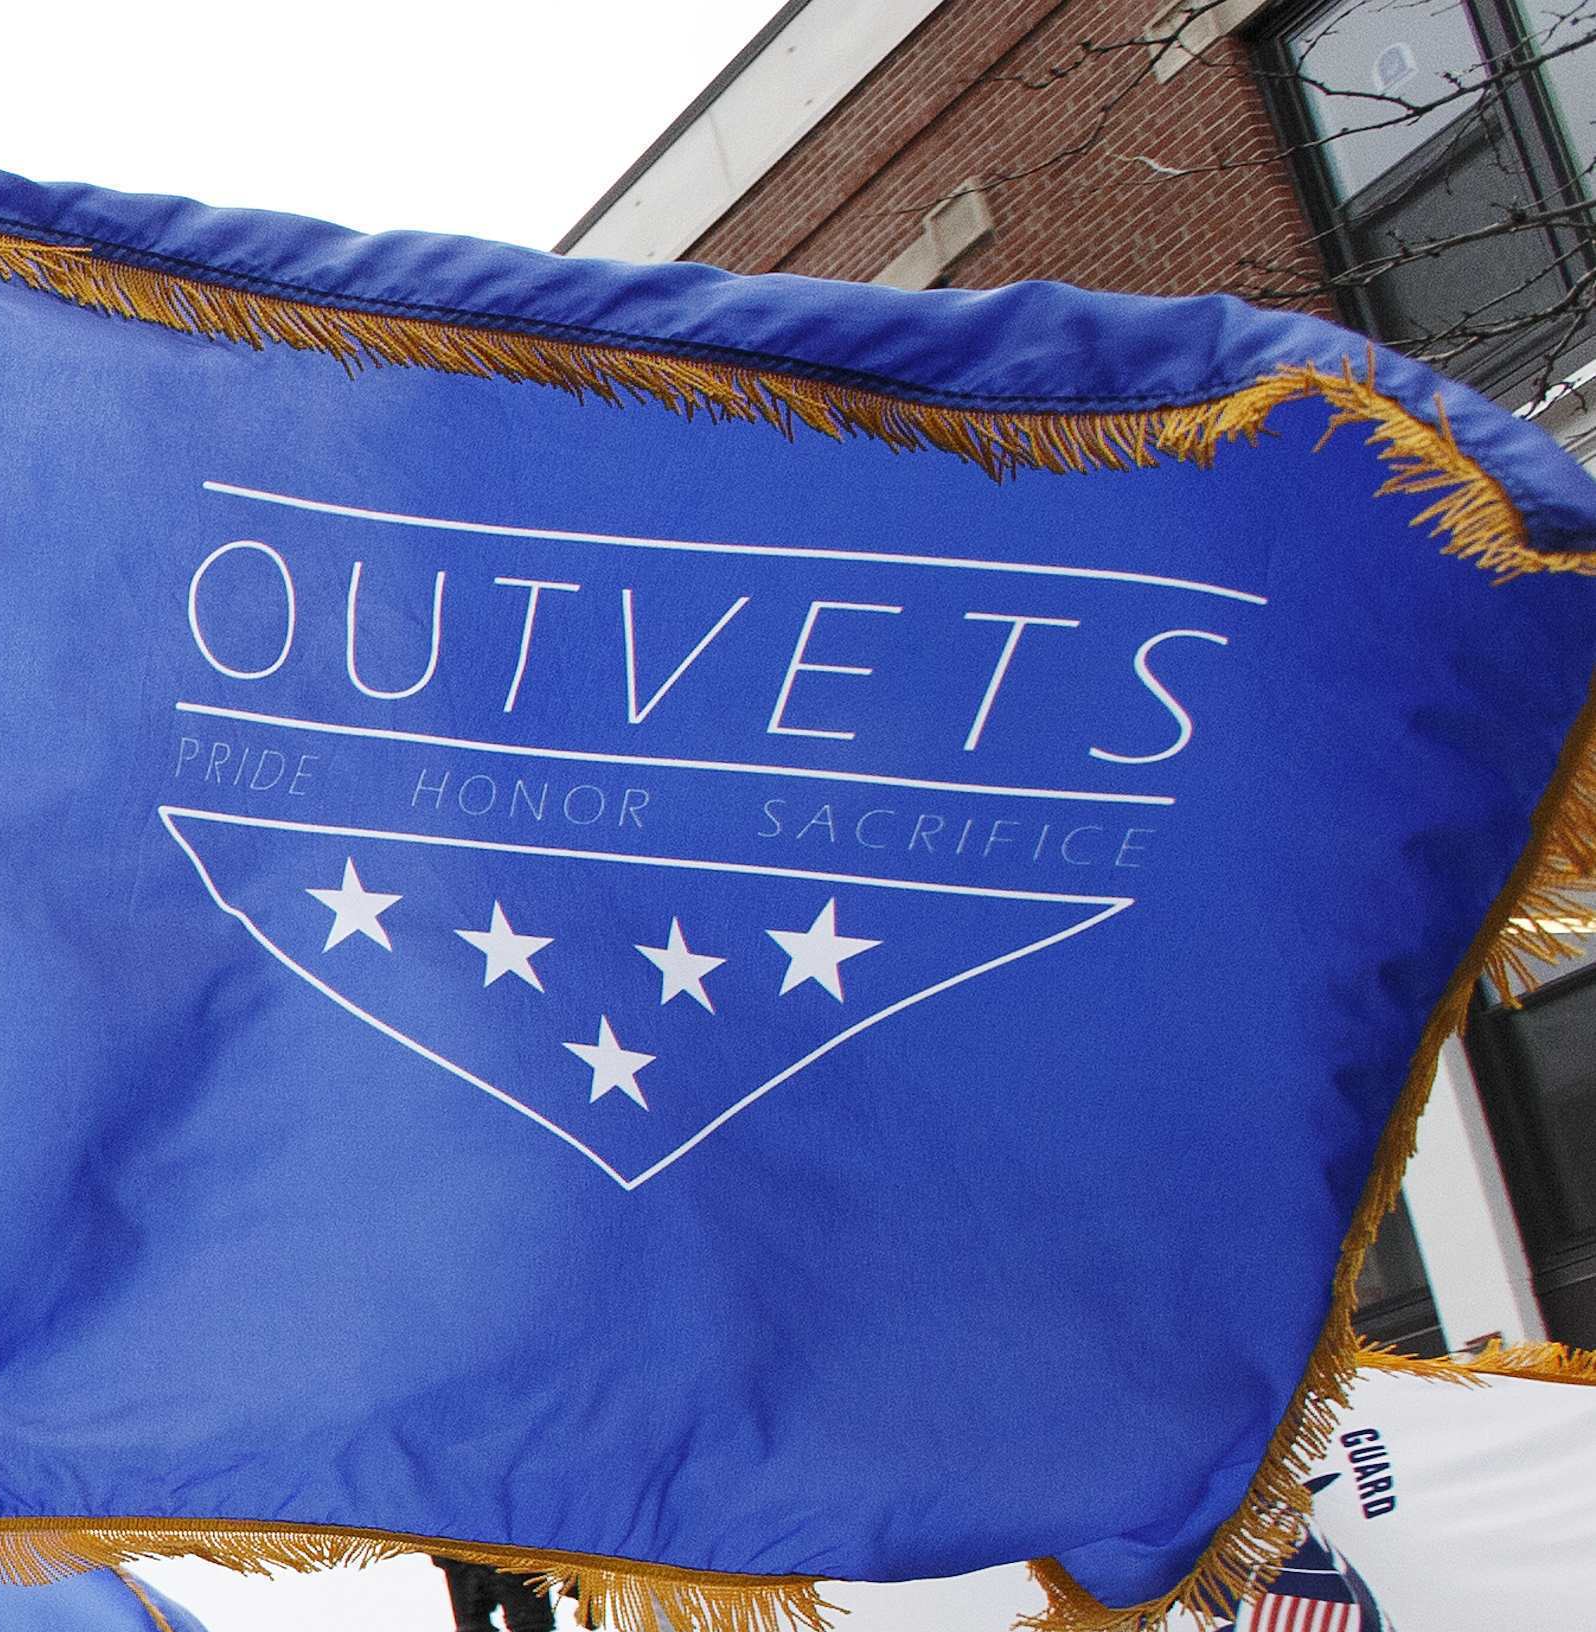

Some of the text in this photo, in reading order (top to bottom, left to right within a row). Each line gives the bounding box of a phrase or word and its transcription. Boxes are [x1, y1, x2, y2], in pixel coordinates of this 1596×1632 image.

[188, 540, 1229, 765] OUTVETS
[174, 735, 1156, 869] PRIDE HONOR SACRIFICE
[1340, 1426, 1396, 1519] GUARD
